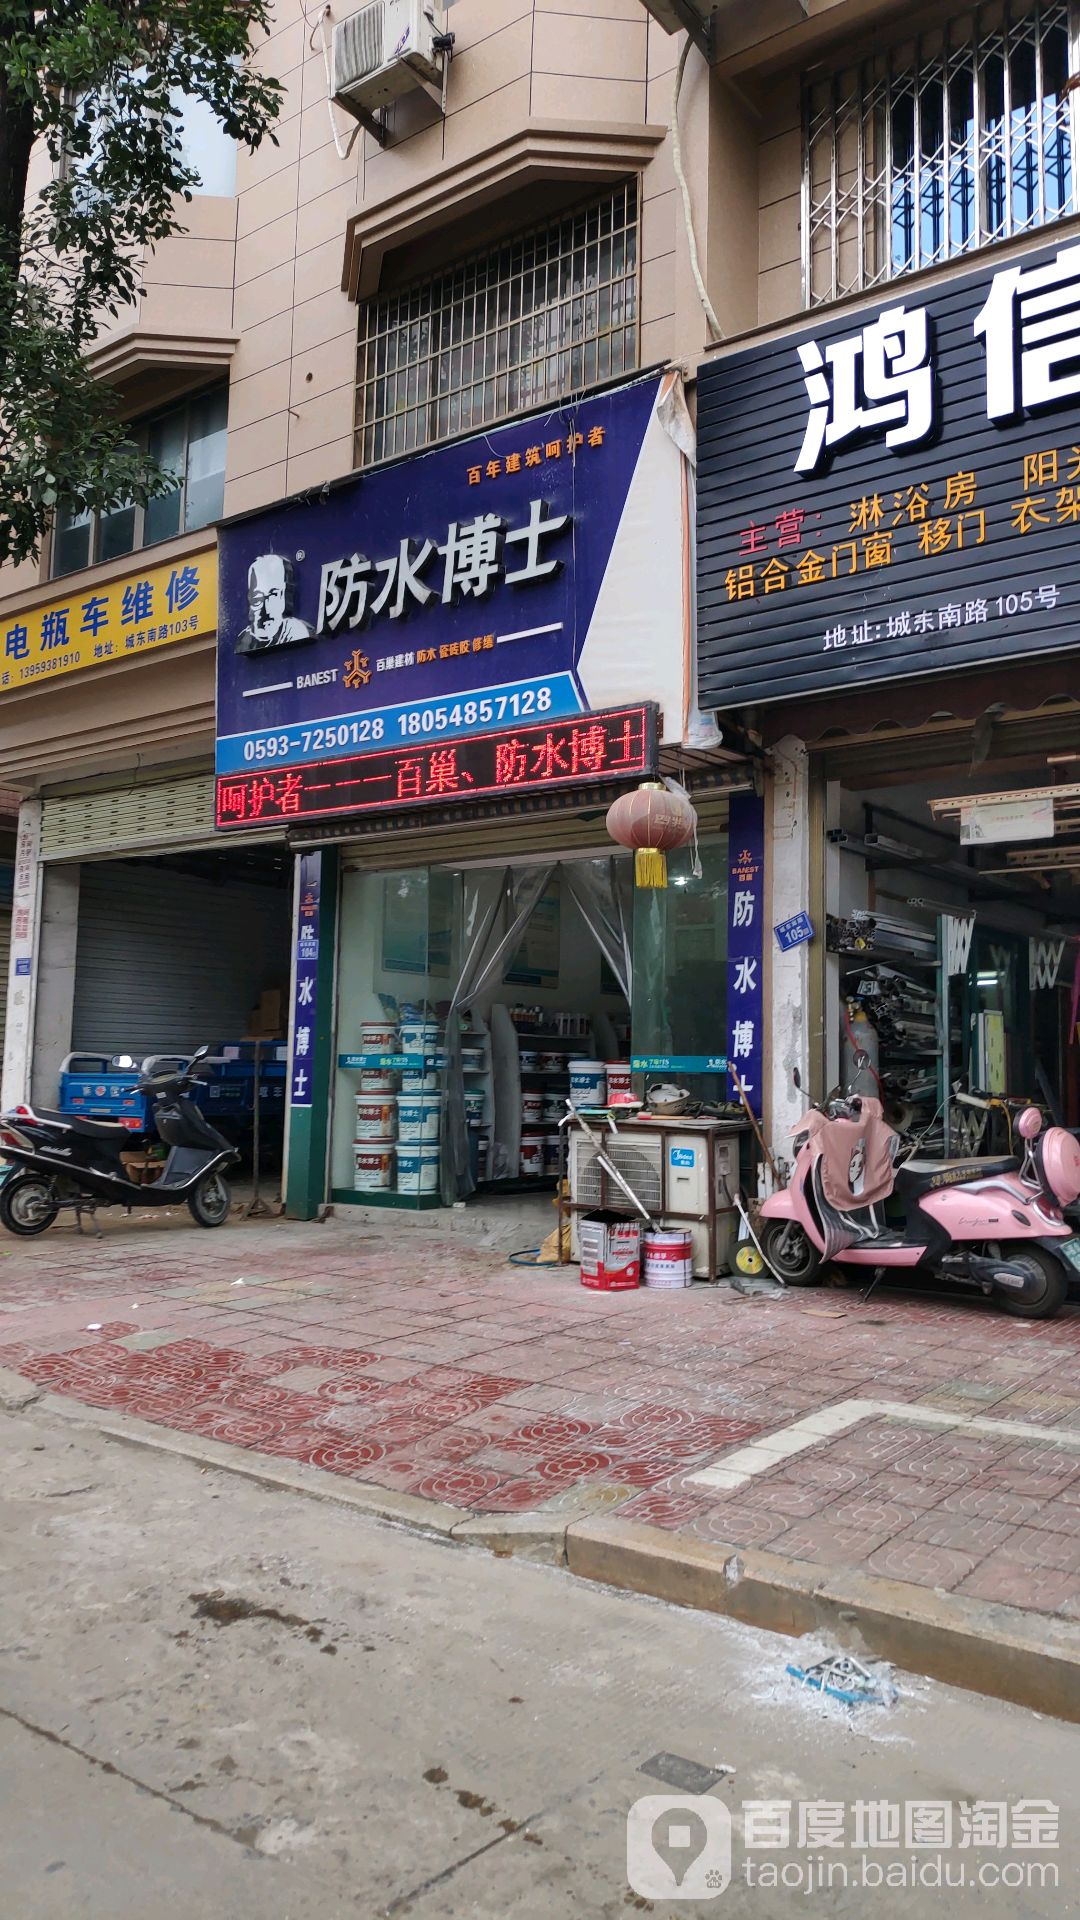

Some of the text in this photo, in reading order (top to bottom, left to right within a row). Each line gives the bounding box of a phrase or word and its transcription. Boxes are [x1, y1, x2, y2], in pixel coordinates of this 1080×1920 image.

[793, 243, 1080, 473] 鸿信
[466, 425, 607, 486] 百年建筑呵护者
[848, 470, 979, 534] 淋浴房
[315, 498, 571, 637] 防水博士
[724, 531, 894, 601] 铝合金门窗
[917, 509, 987, 556] 移门
[4, 566, 201, 661] 电瓶车维修
[296, 668, 339, 689] BANEST
[416, 647, 437, 664] 防水
[243, 687, 552, 762] 0593-7250128 18054857128
[731, 889, 757, 1105] 防水博士
